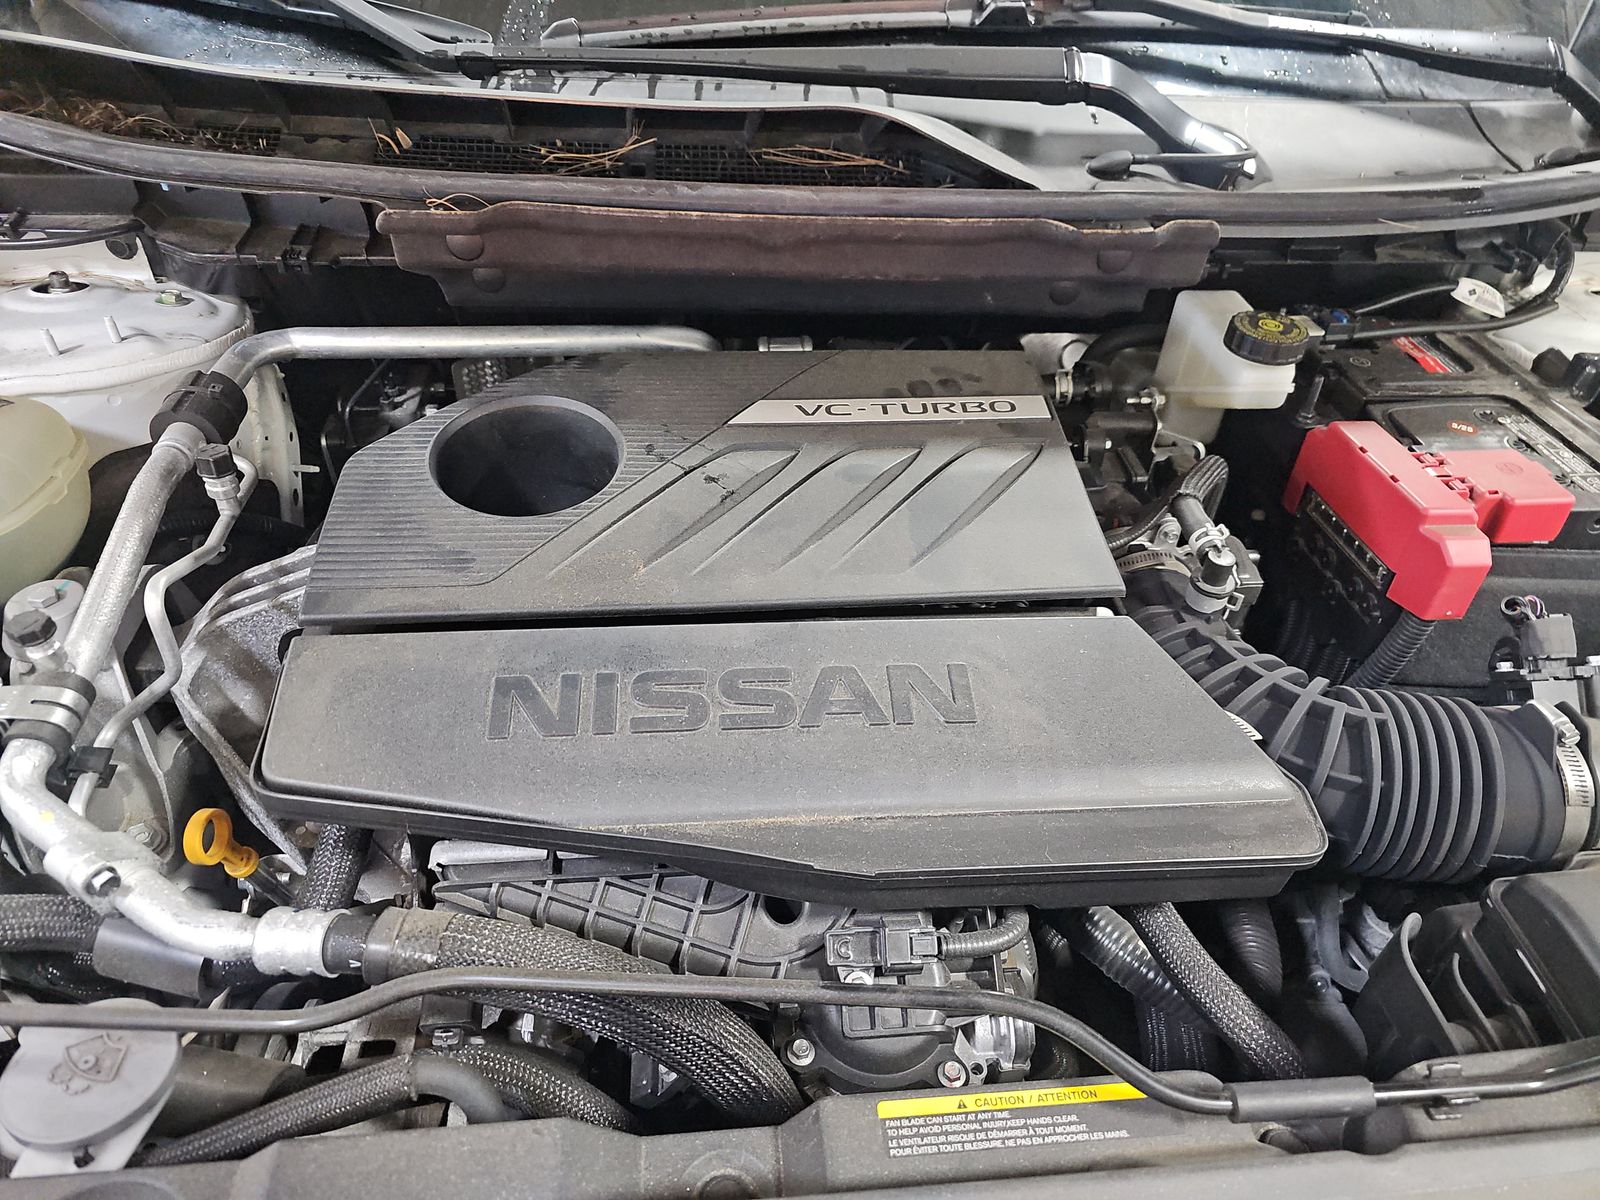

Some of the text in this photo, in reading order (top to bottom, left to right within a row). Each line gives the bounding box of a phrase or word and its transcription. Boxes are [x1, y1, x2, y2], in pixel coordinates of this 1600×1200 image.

[794, 400, 1017, 416] VC-TURBO
[485, 663, 978, 740] NISSAN
[974, 1095, 1025, 1108] CAUTION
[1037, 1090, 1098, 1102] ATTENTION
[886, 1119, 900, 1127] FAN
[901, 1117, 926, 1126] BLADE
[926, 1116, 943, 1124] CAN
[943, 1114, 967, 1123] START
[967, 1113, 976, 1121] AT
[977, 1112, 993, 1120] ANY
[887, 1128, 897, 1137] TO
[899, 1127, 918, 1136] HELP
[919, 1125, 941, 1134] AVOID
[942, 1122, 982, 1132] PERSONAL
[1027, 1115, 1052, 1125] HANDS
[888, 1139, 898, 1147] LE
[899, 1135, 947, 1147] VENTILATEUR
[947, 1133, 975, 1142] RISQUE
[976, 1132, 987, 1140] DE
[987, 1127, 1028, 1139] DÉMARRER
[1035, 1126, 1054, 1135] TOUT
[890, 1147, 912, 1157] POUR
[913, 1145, 938, 1155] ÉVITER
[939, 1143, 964, 1153] TOUTE
[1005, 1138, 1016, 1147] NE
[1017, 1137, 1032, 1146] PAS
[1033, 1136, 1044, 1145] EN
[1044, 1133, 1089, 1144] APPROCHER
[1090, 1131, 1104, 1140] LES
